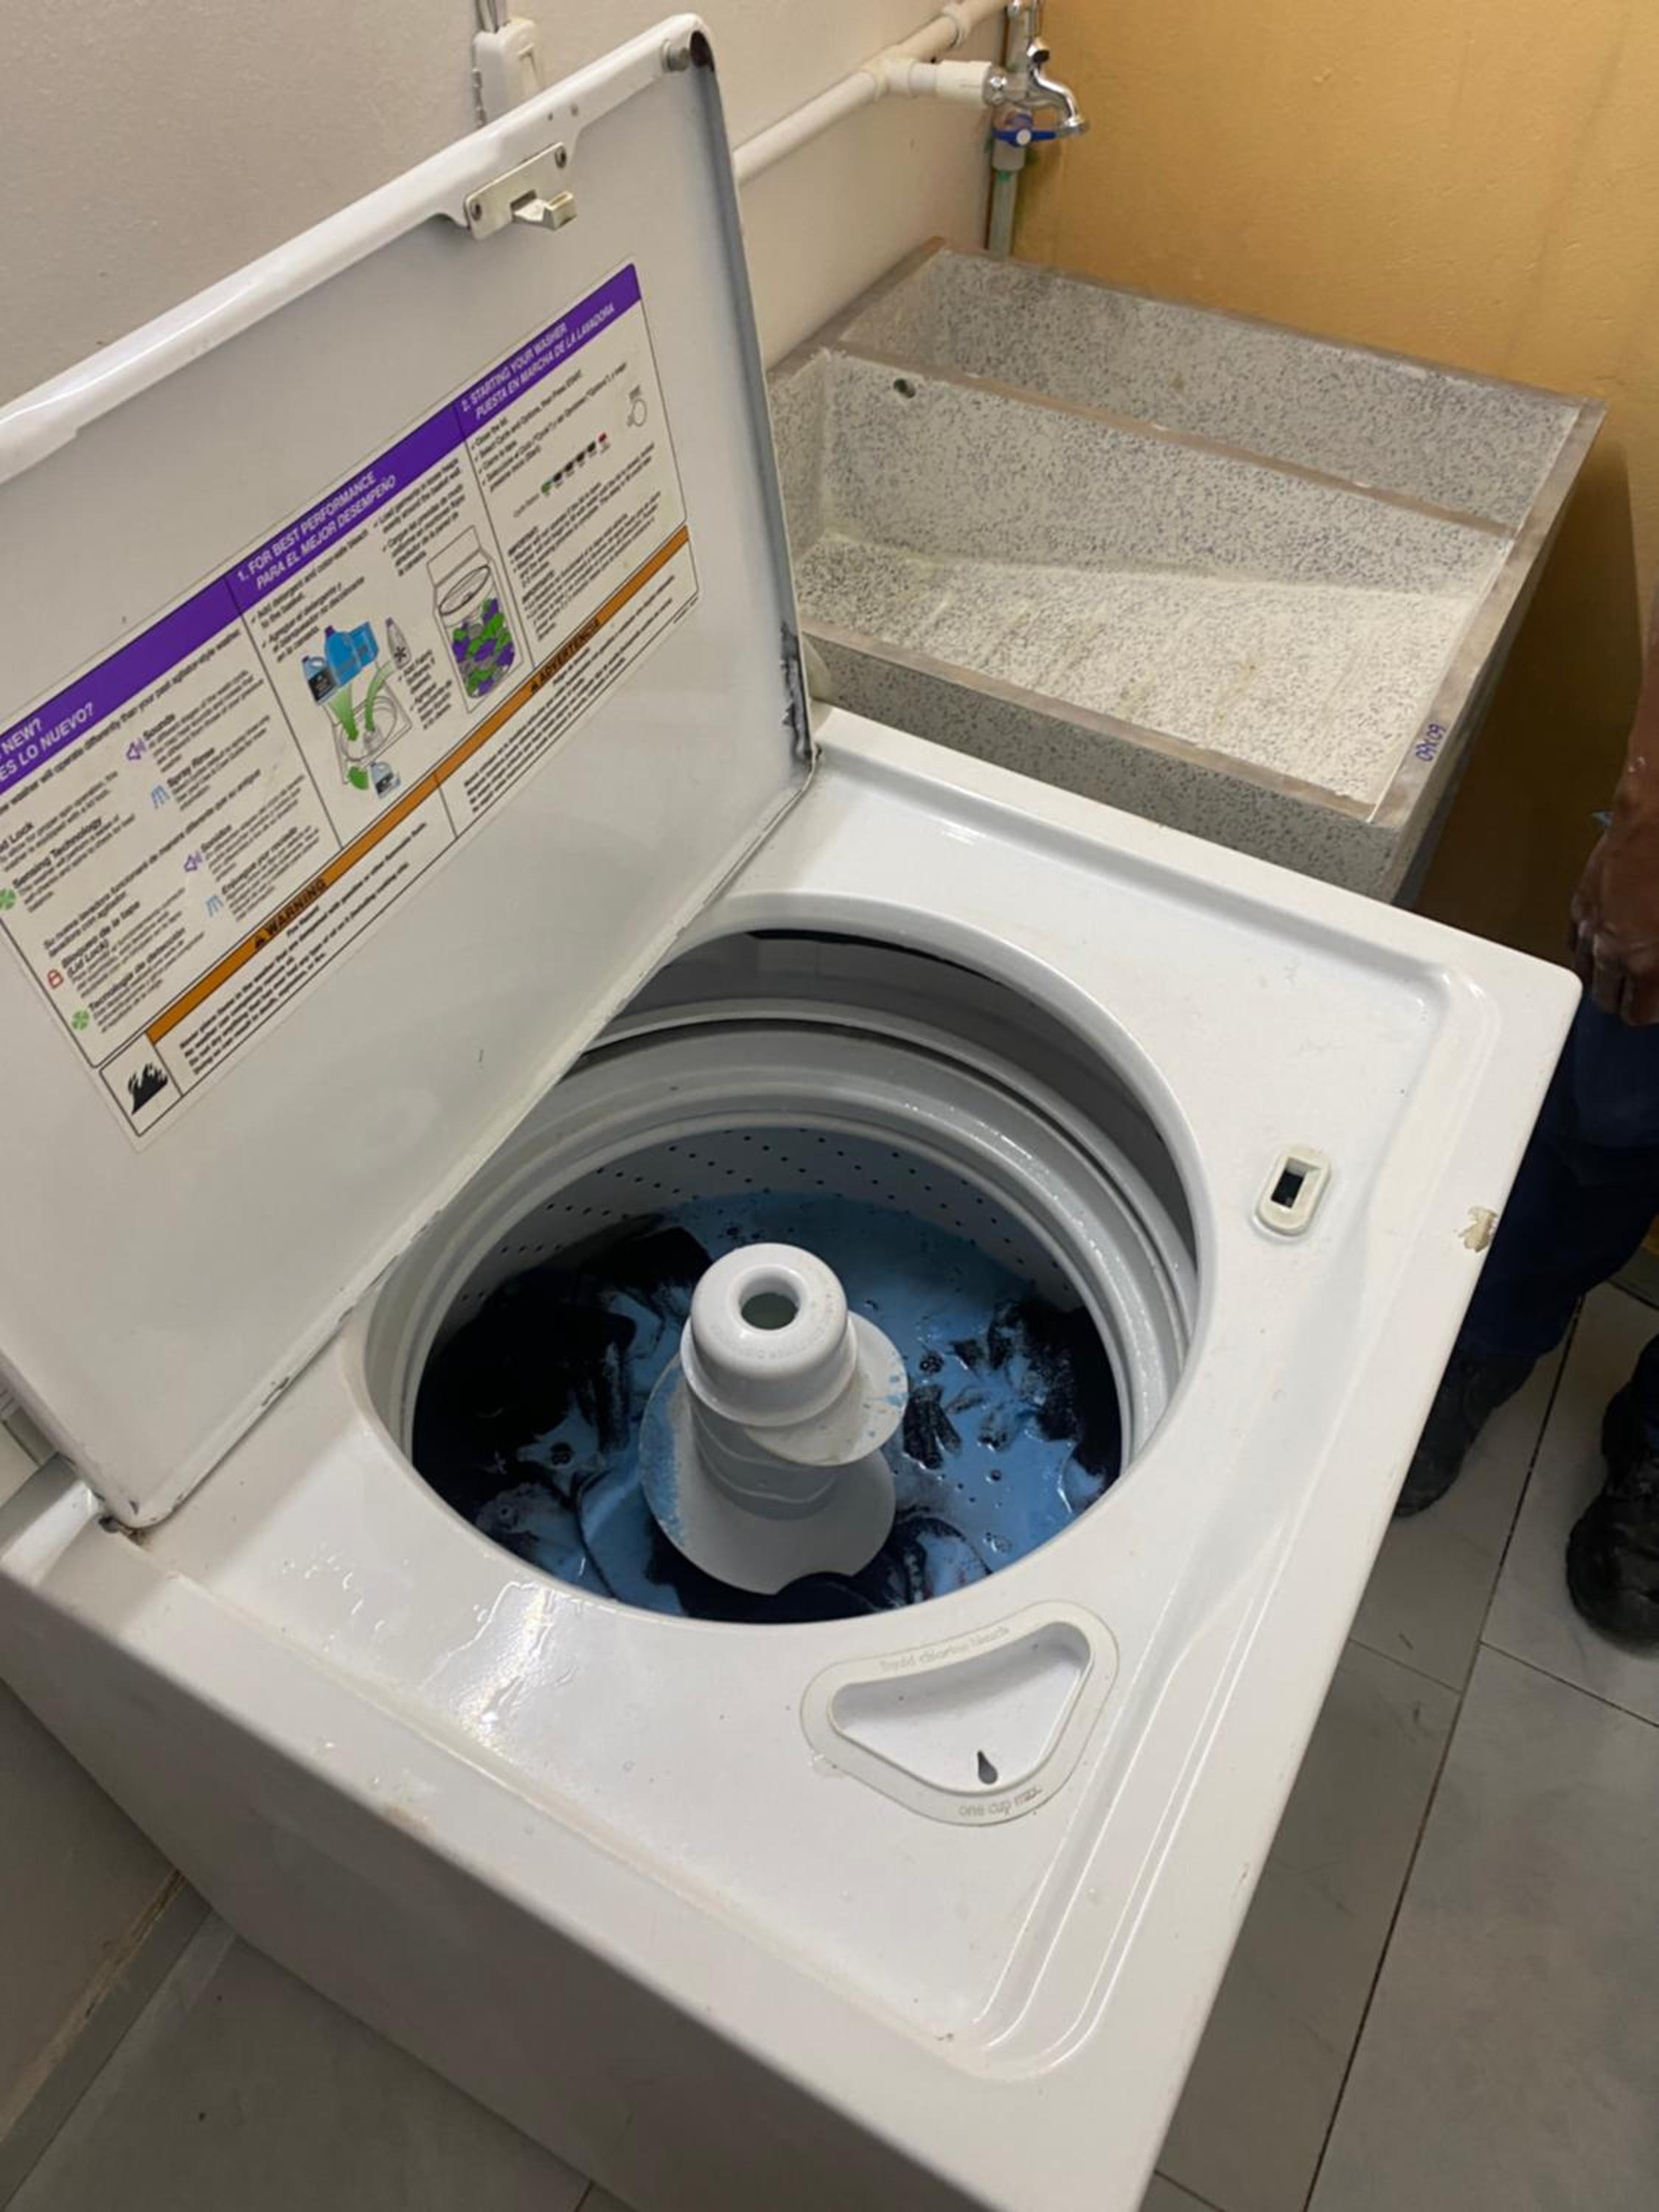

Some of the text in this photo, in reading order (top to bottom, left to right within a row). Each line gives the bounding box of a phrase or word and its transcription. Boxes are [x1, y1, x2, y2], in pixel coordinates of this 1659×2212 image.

[470, 366, 511, 404] STARTING
[509, 347, 534, 372] YOUR
[507, 378, 520, 394] EN
[554, 340, 565, 357] DE
[565, 332, 577, 349] LA
[237, 569, 249, 581] 1.
[248, 549, 273, 574] FOR
[271, 527, 299, 557] BEST
[299, 471, 375, 535] PERFORMANCE
[256, 560, 286, 589] PARA
[285, 550, 300, 567] EL
[299, 520, 337, 555] MEJOR
[336, 474, 395, 528] DESEMPEÑO
[0, 717, 41, 754] NEW?
[18, 743, 38, 766] LO
[39, 701, 93, 751] NUEVO?
[142, 713, 175, 741] Sounds
[11, 816, 102, 889] Sensing Technology
[264, 877, 327, 936] WARNING
[958, 1804, 984, 1818] one
[989, 1800, 1012, 1817] cup
